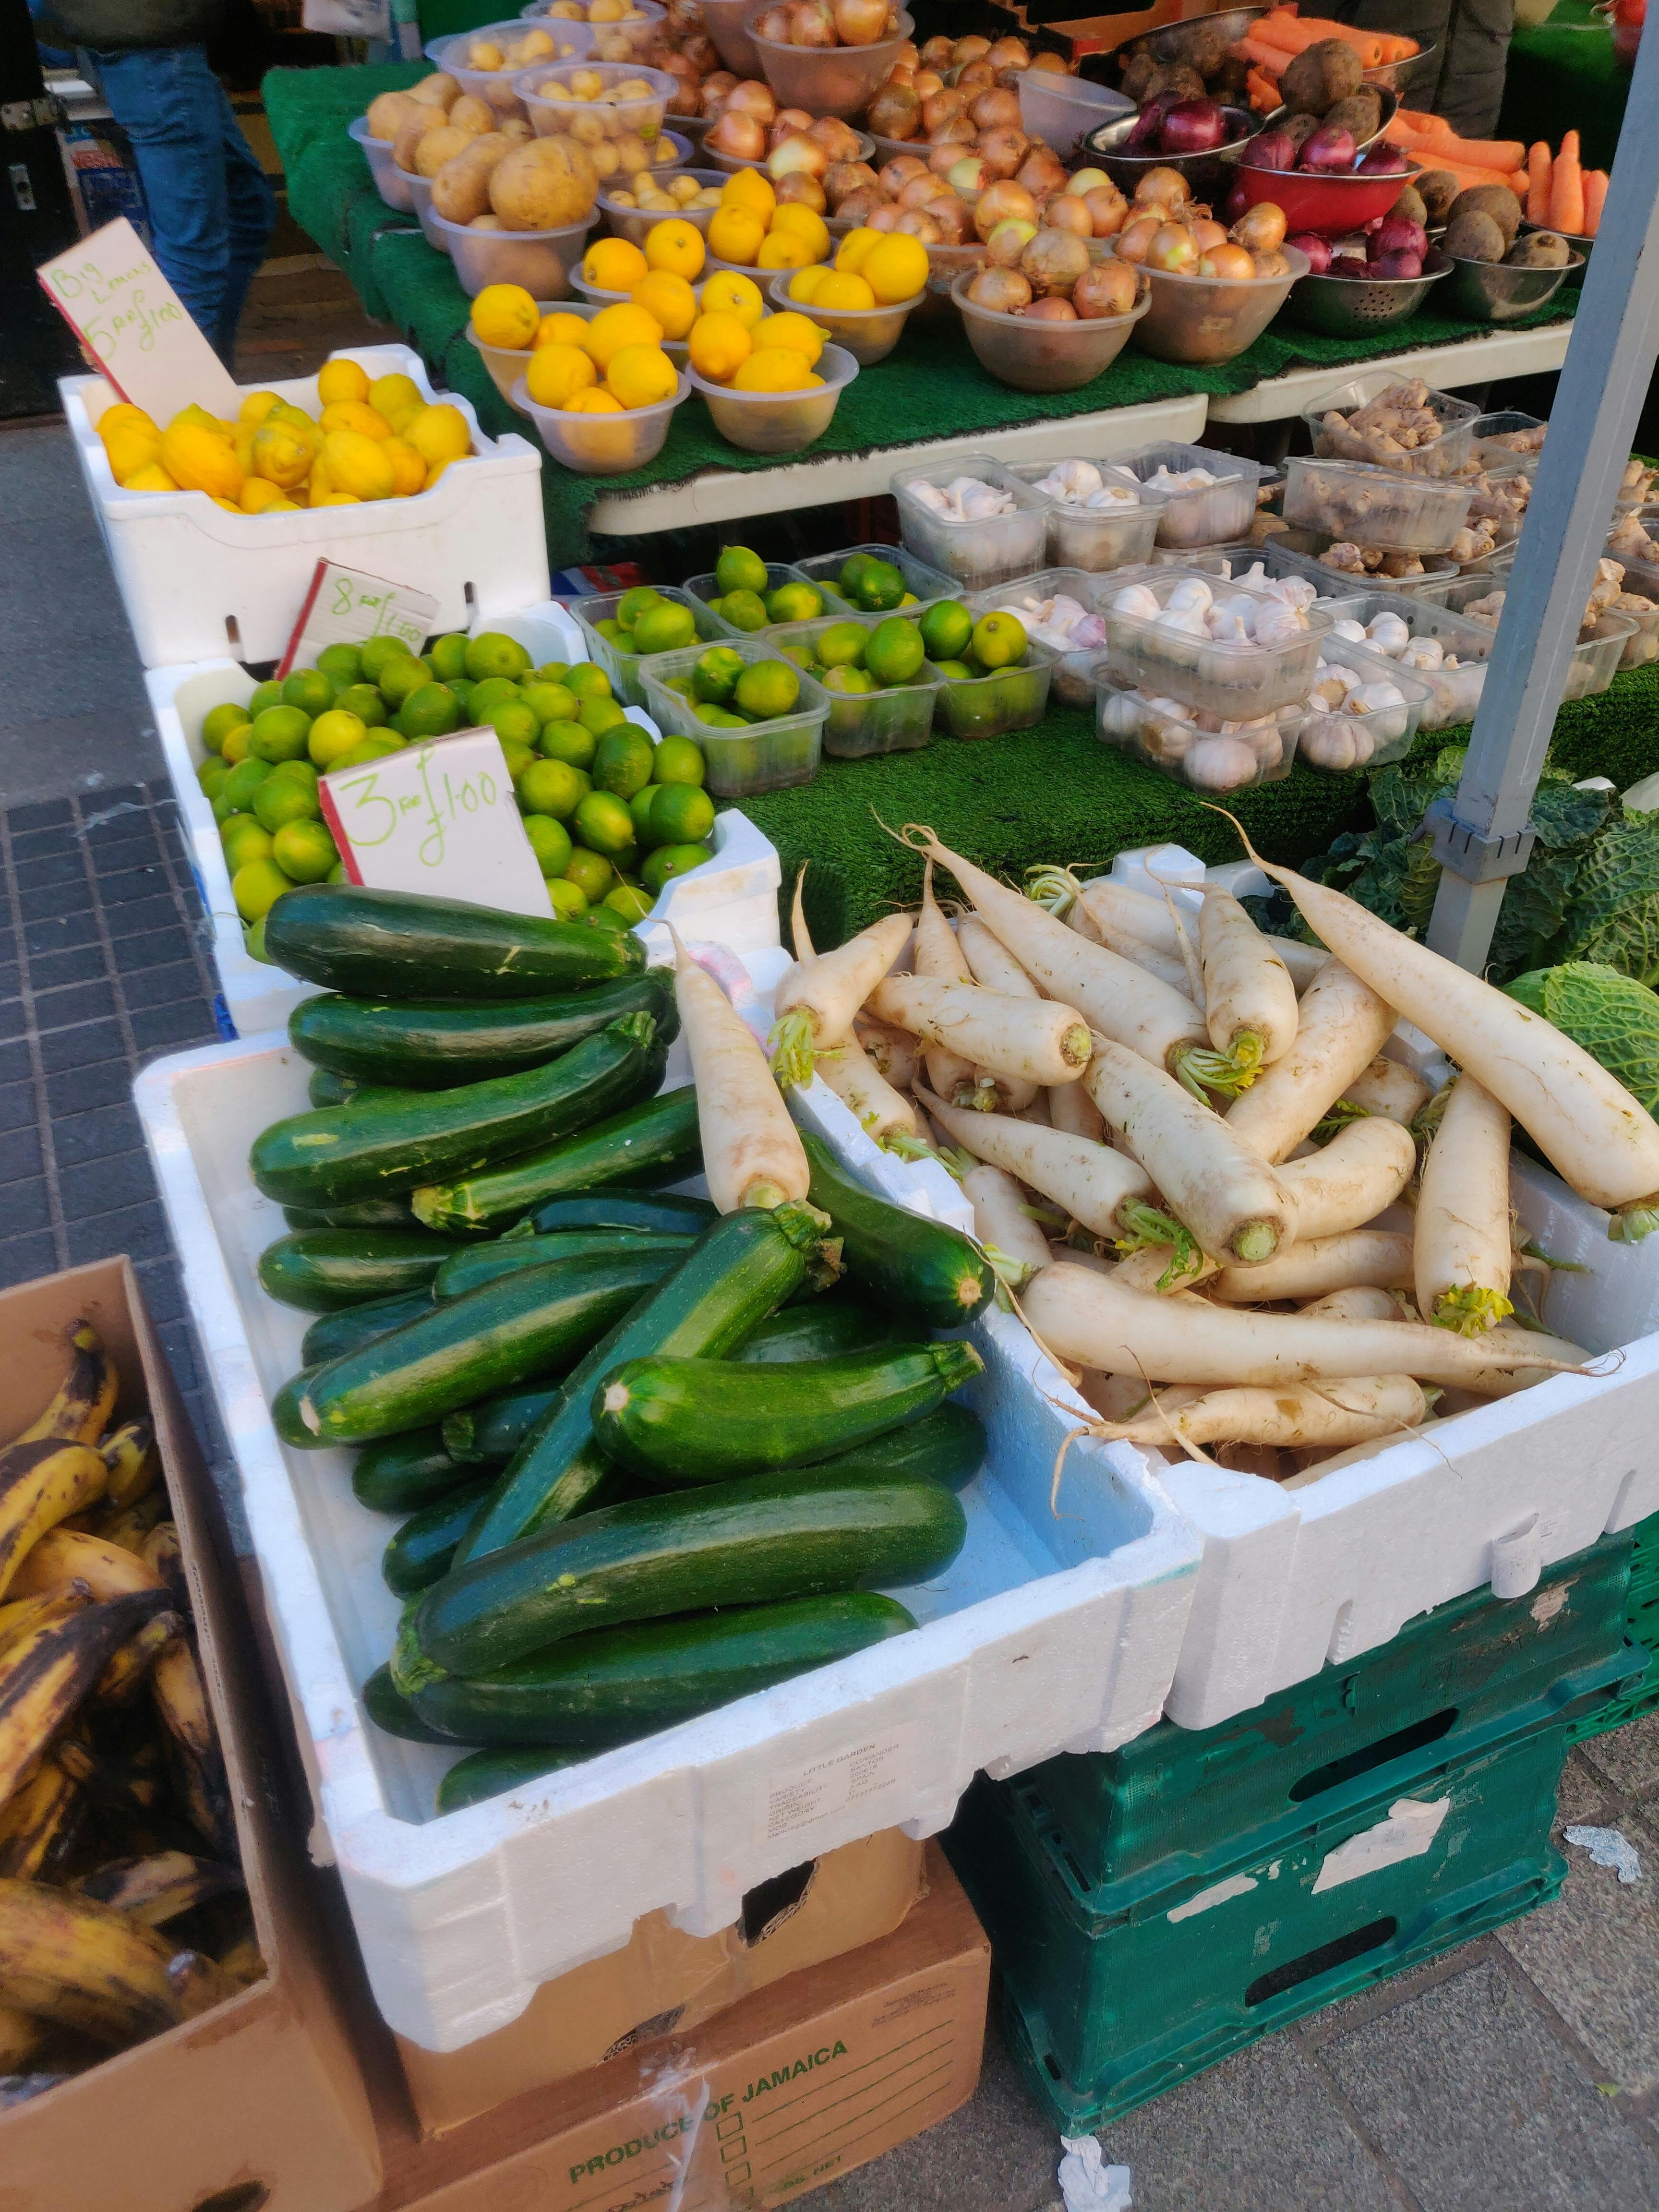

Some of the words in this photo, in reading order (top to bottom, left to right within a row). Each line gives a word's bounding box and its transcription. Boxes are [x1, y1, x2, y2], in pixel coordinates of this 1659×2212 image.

[331, 577, 354, 615] 8
[339, 773, 397, 847] 3
[803, 1759, 834, 1776] LITTLE
[837, 1743, 875, 1763] GARDEN
[850, 1744, 899, 1767] CORIANDER
[851, 1771, 875, 1783] SPAIN
[769, 1812, 785, 1821] NET
[569, 2117, 694, 2184] PRODUCE
[703, 2093, 735, 2123] OF
[742, 2040, 849, 2103] JAMAICA
